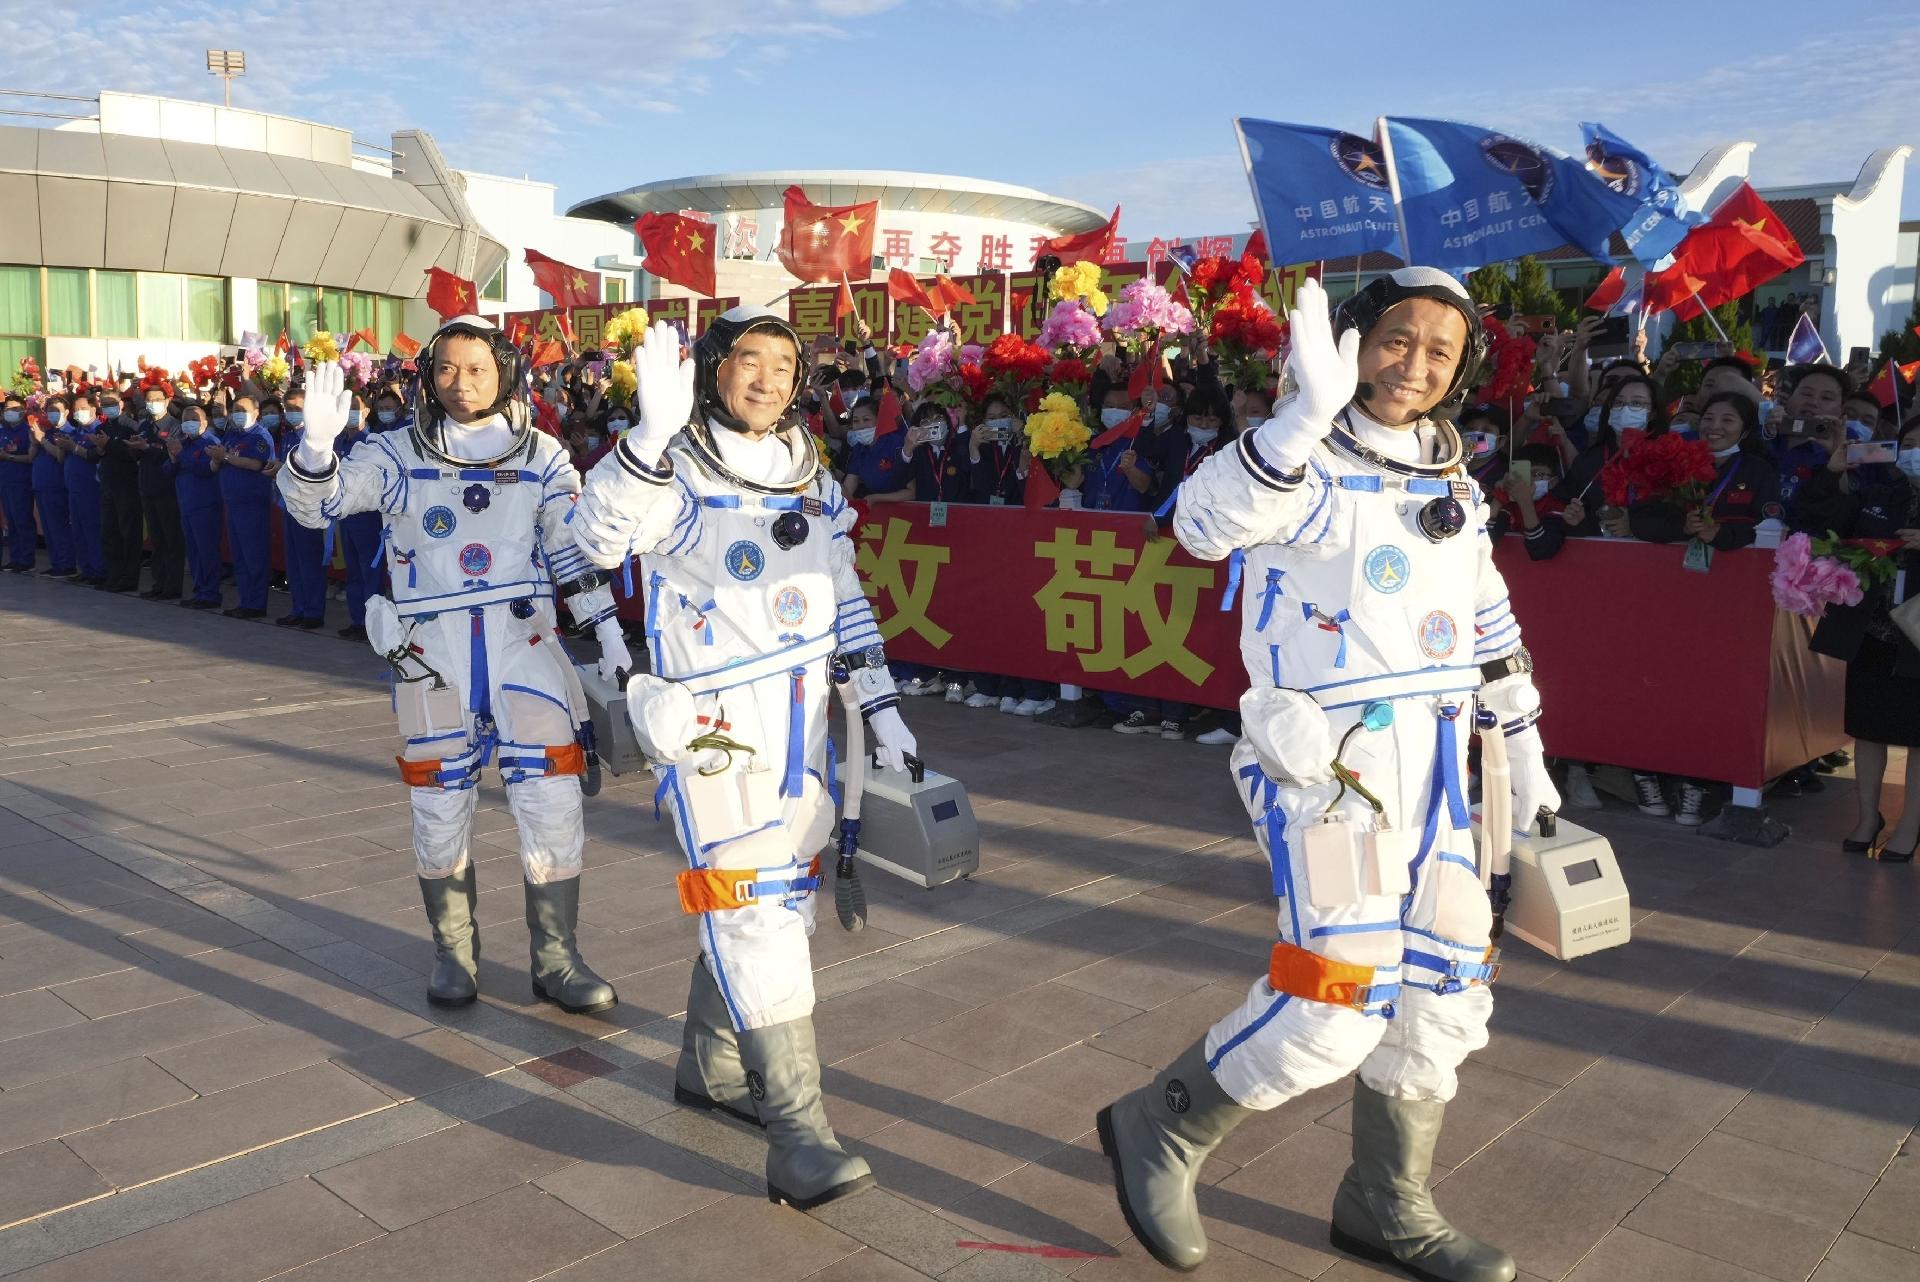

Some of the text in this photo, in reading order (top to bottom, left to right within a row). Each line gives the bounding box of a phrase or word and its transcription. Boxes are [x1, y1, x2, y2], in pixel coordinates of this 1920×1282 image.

[1295, 195, 1387, 222] 中国航天
[1300, 221, 1362, 240] ASTRONAUT
[1443, 220, 1513, 248] ASTRONAUT
